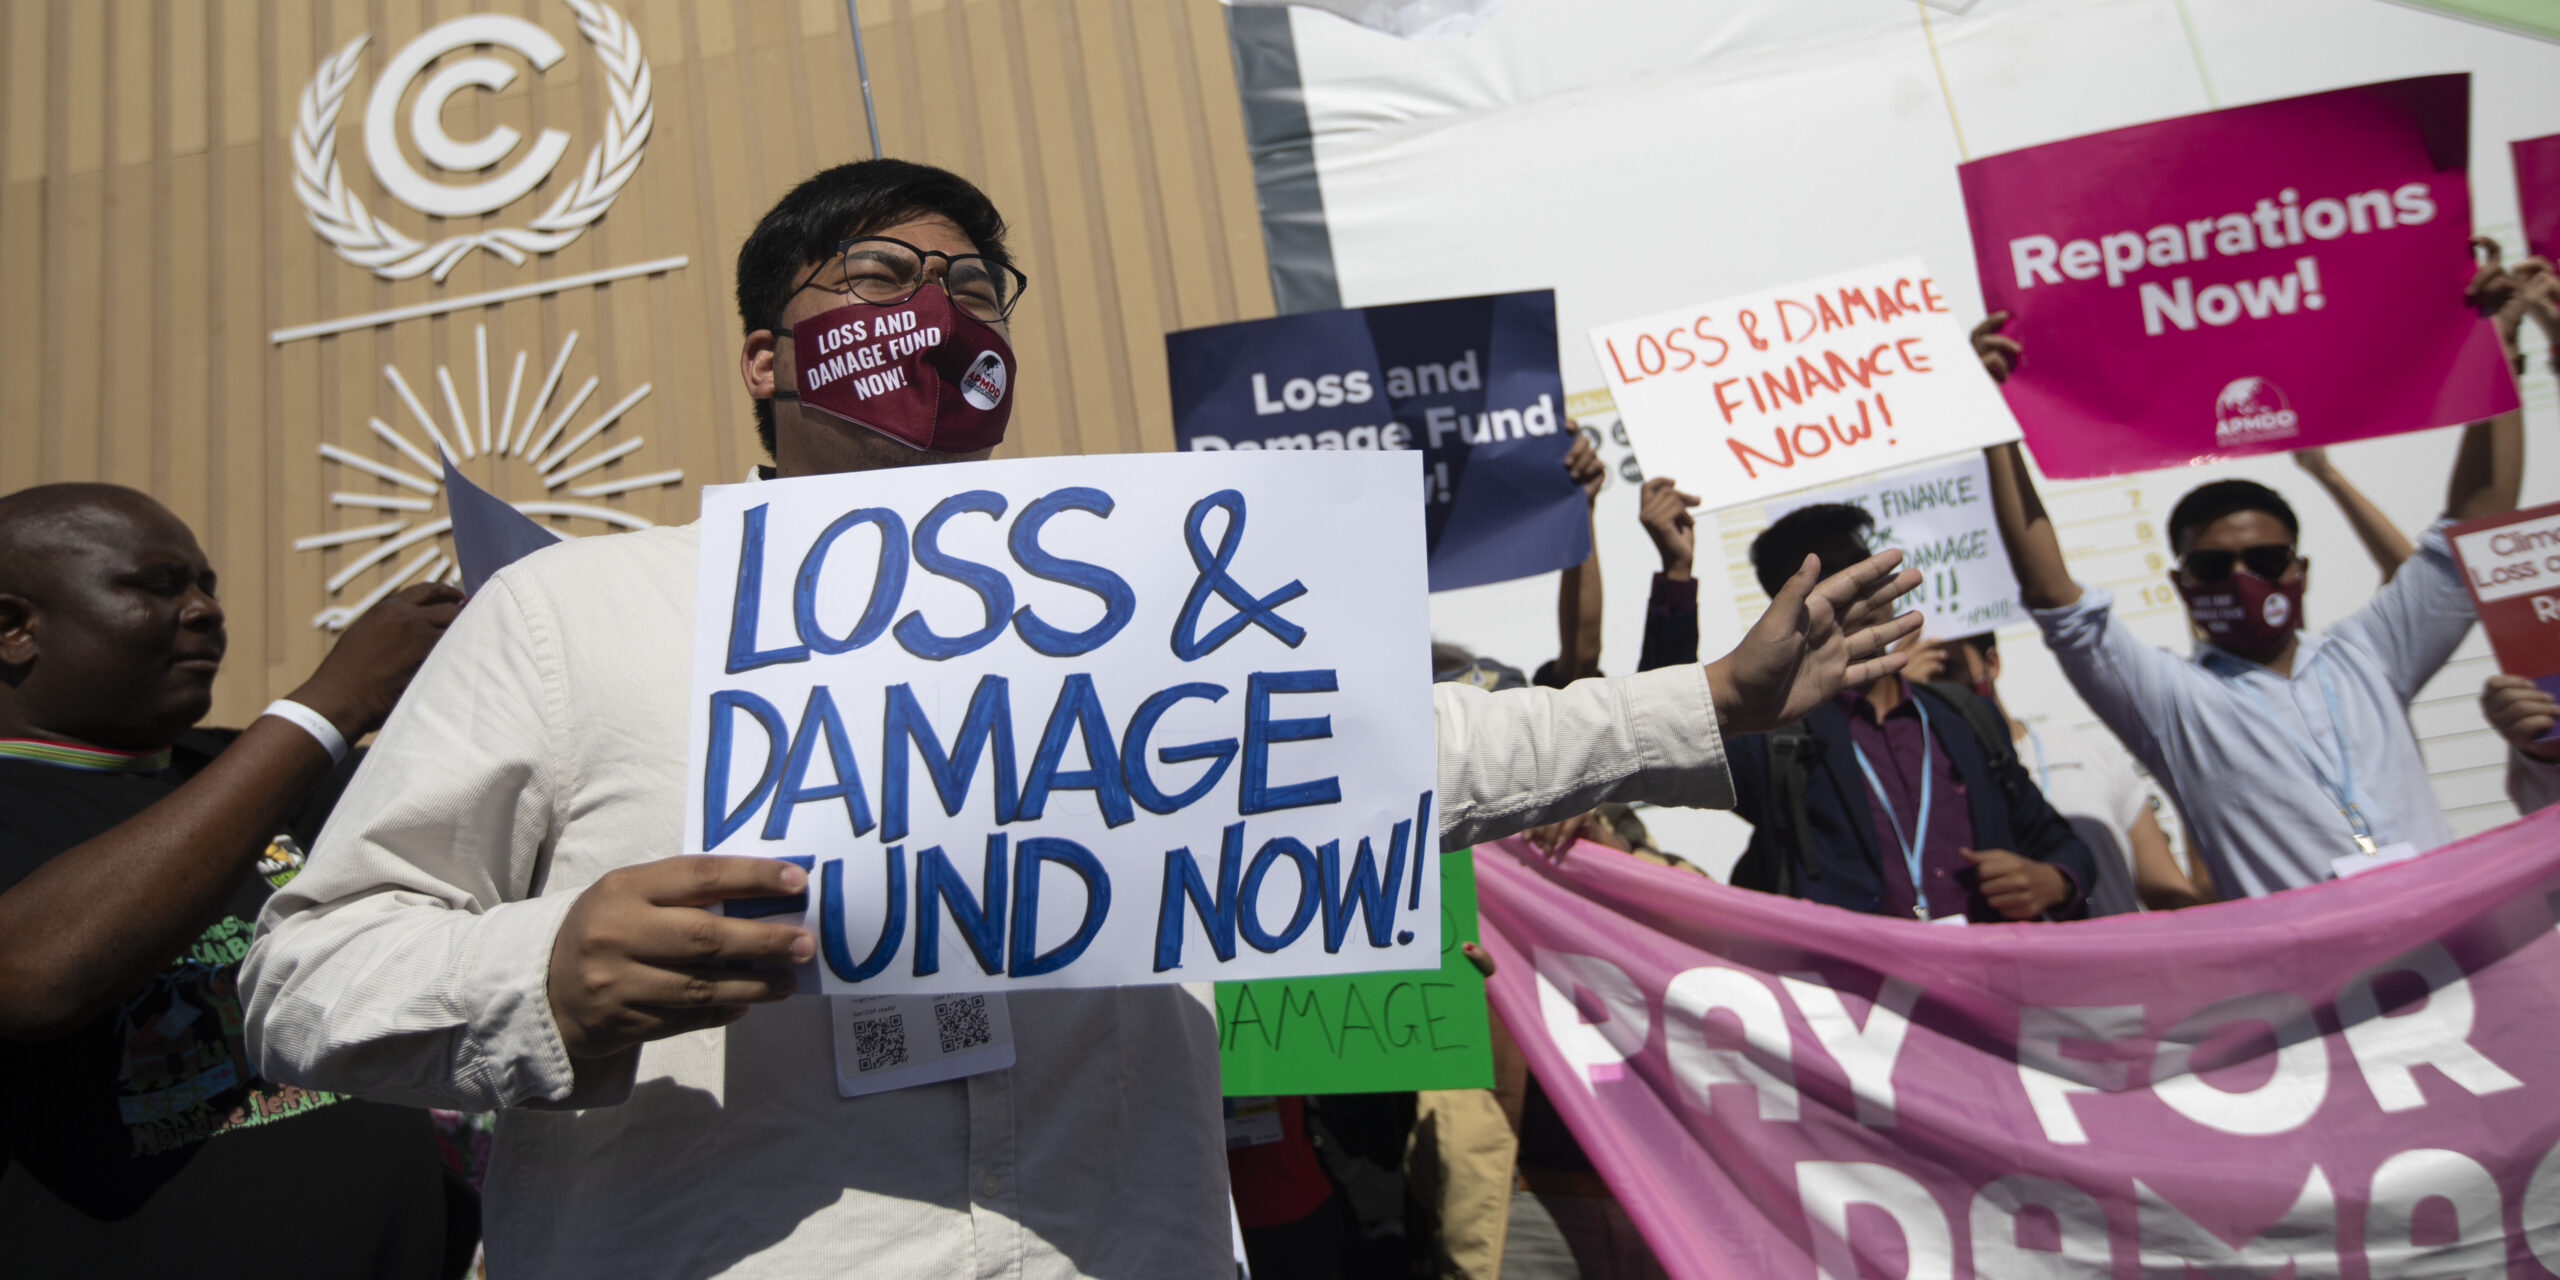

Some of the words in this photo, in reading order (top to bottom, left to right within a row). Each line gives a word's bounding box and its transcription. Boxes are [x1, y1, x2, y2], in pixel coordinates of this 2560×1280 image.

[2009, 183, 2437, 290] Reparations
[818, 320, 868, 355] LOSS
[874, 310, 917, 337] AND
[1606, 316, 1729, 384] LOSS
[1738, 309, 1769, 351] &
[1776, 278, 1950, 343] DAMAGE
[2139, 256, 2326, 337] Now!
[807, 342, 887, 392] DAMAGE
[889, 327, 941, 361] FUND
[853, 365, 908, 401] NOW!
[968, 371, 1001, 398] APMDD
[1252, 370, 1373, 416] Loss
[1387, 350, 1481, 398] and
[1713, 338, 1934, 424] FINANCE
[1424, 394, 1557, 450] Fund
[1726, 394, 1897, 478] NOW!
[1881, 475, 1978, 519] FINANCE
[726, 486, 1136, 674] LOSS
[1170, 489, 1308, 662] &
[2470, 561, 2540, 588] Loss
[703, 669, 1343, 852] DAMAGE
[1154, 790, 1433, 972] NOW!
[1533, 948, 1926, 1128] PAY
[2015, 938, 2526, 1145] FOR
